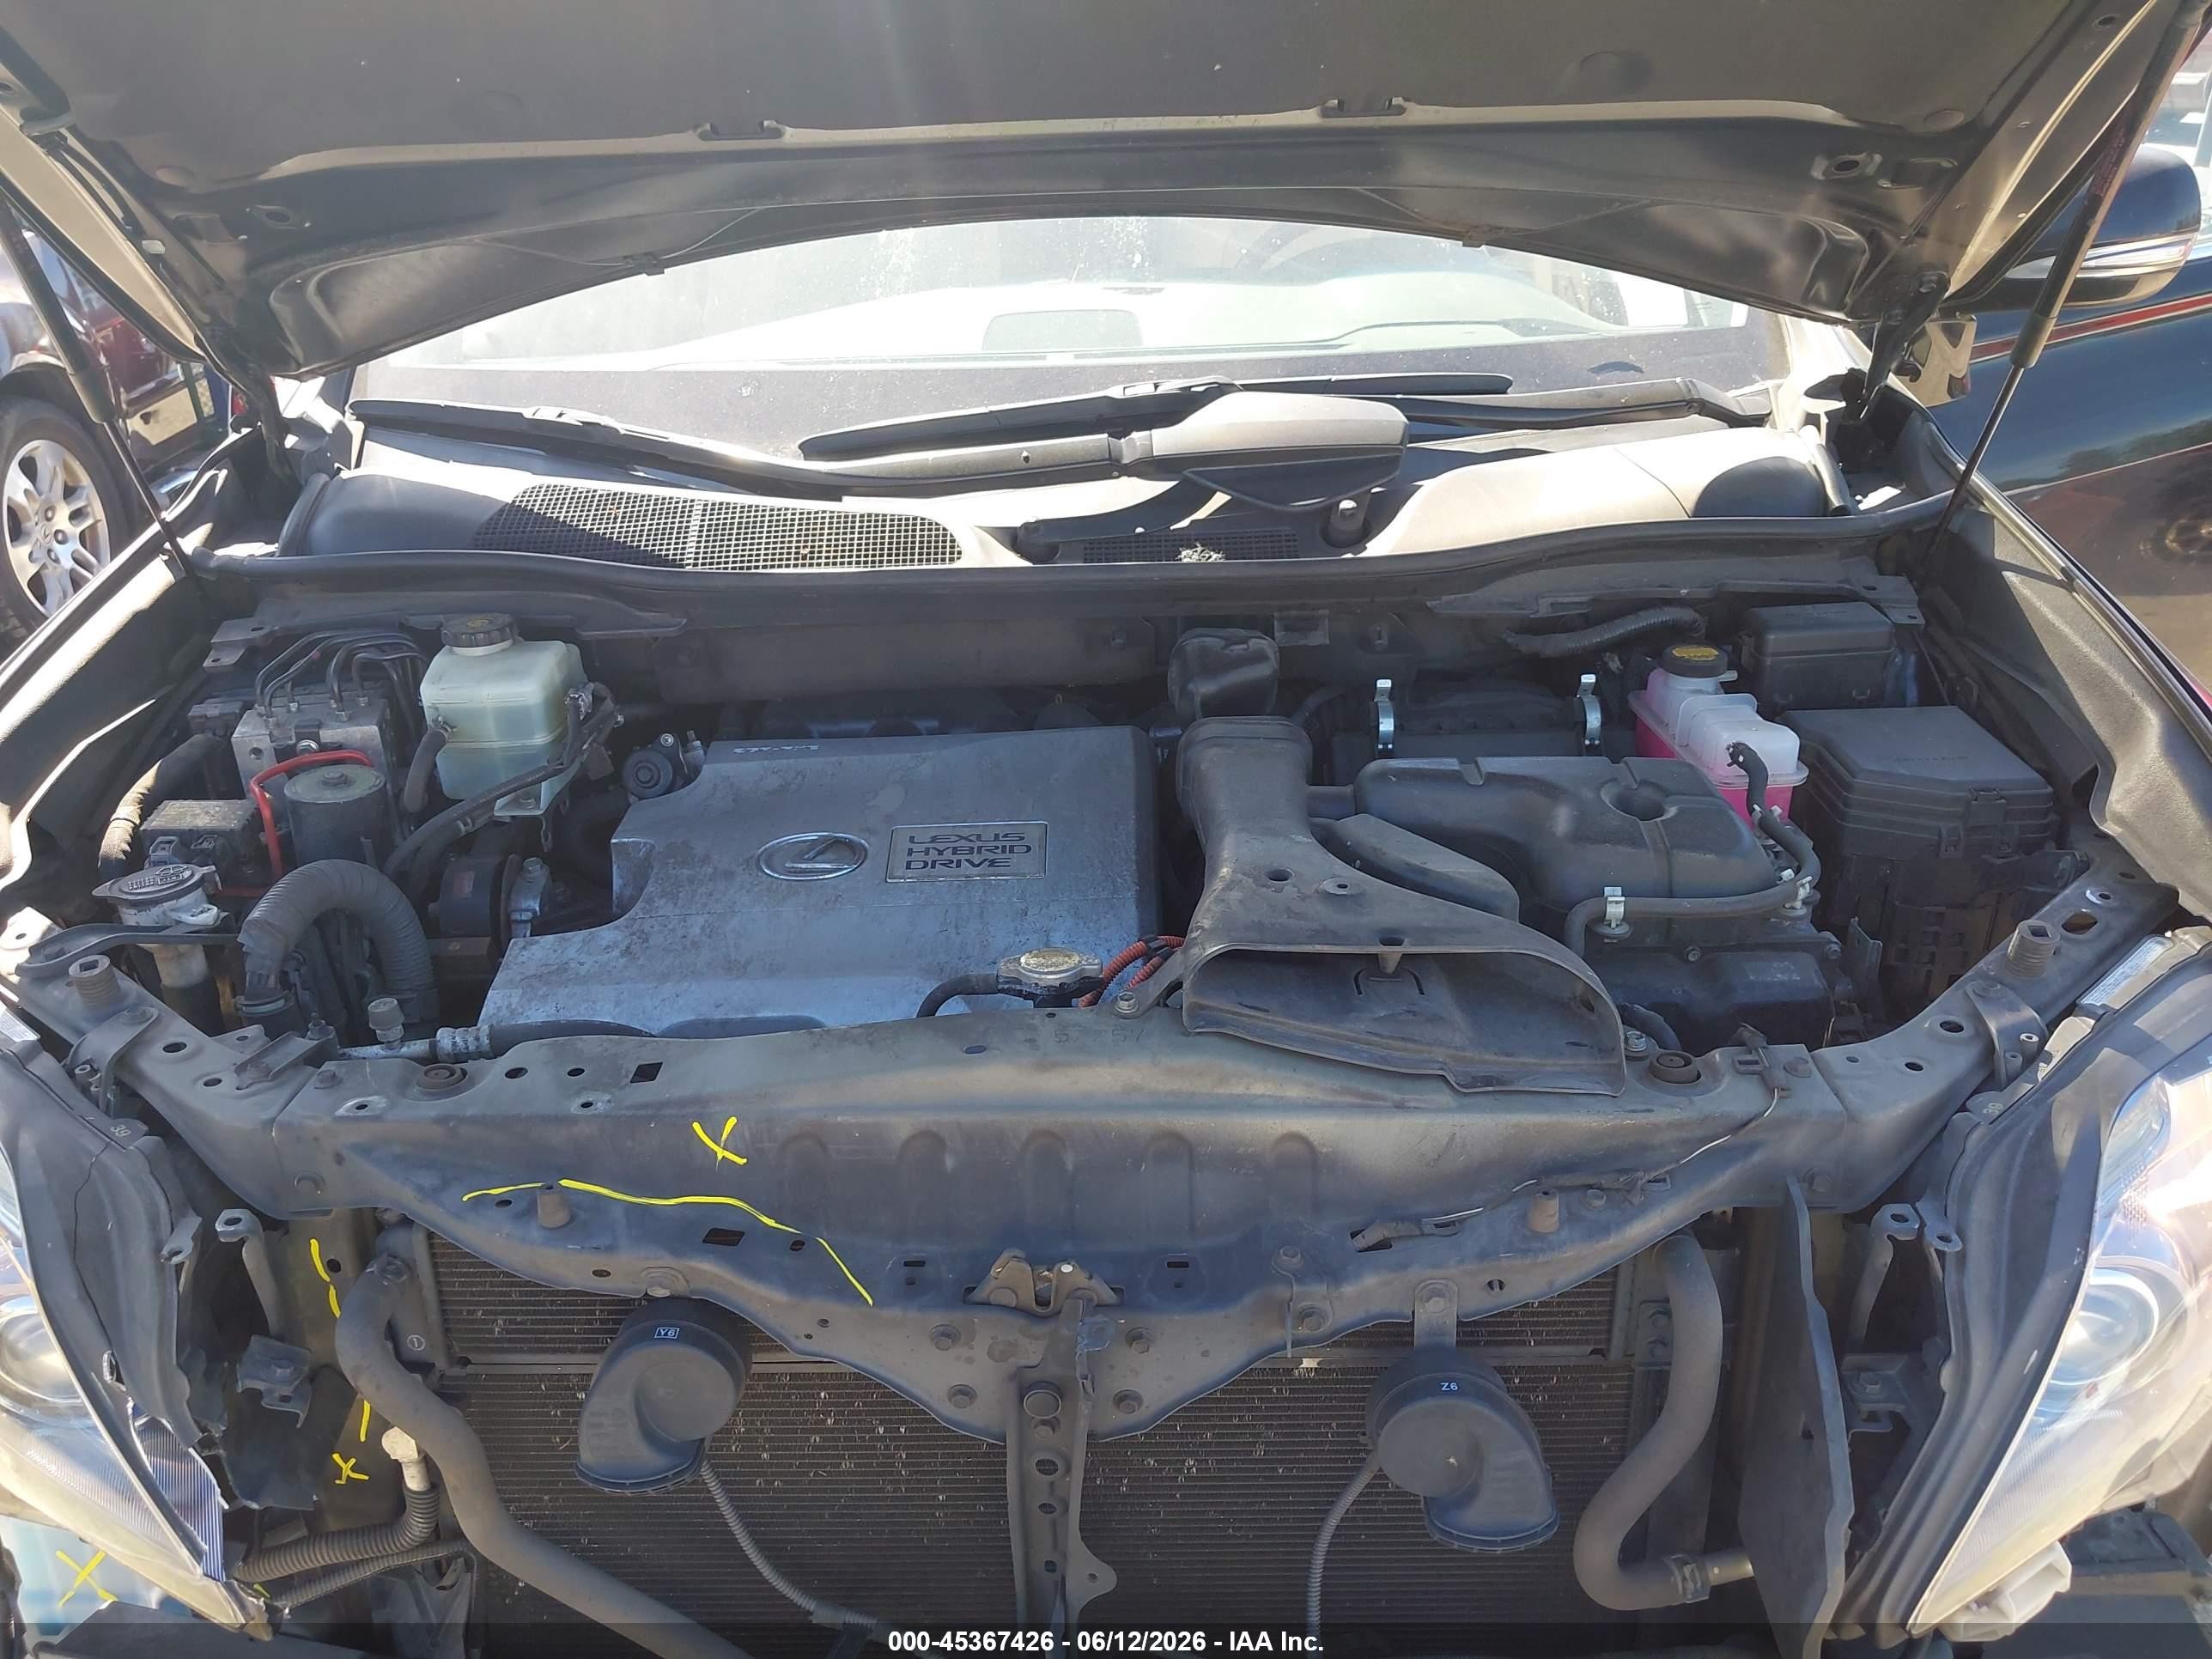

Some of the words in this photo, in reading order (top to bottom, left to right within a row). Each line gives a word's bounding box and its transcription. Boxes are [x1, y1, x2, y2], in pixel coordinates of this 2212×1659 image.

[908, 832, 1026, 844] LEXUS
[907, 844, 1032, 857] HYBRID
[905, 857, 1012, 871] DRIVE
[659, 1328, 675, 1337] Y6
[1440, 1382, 1458, 1391] Z6
